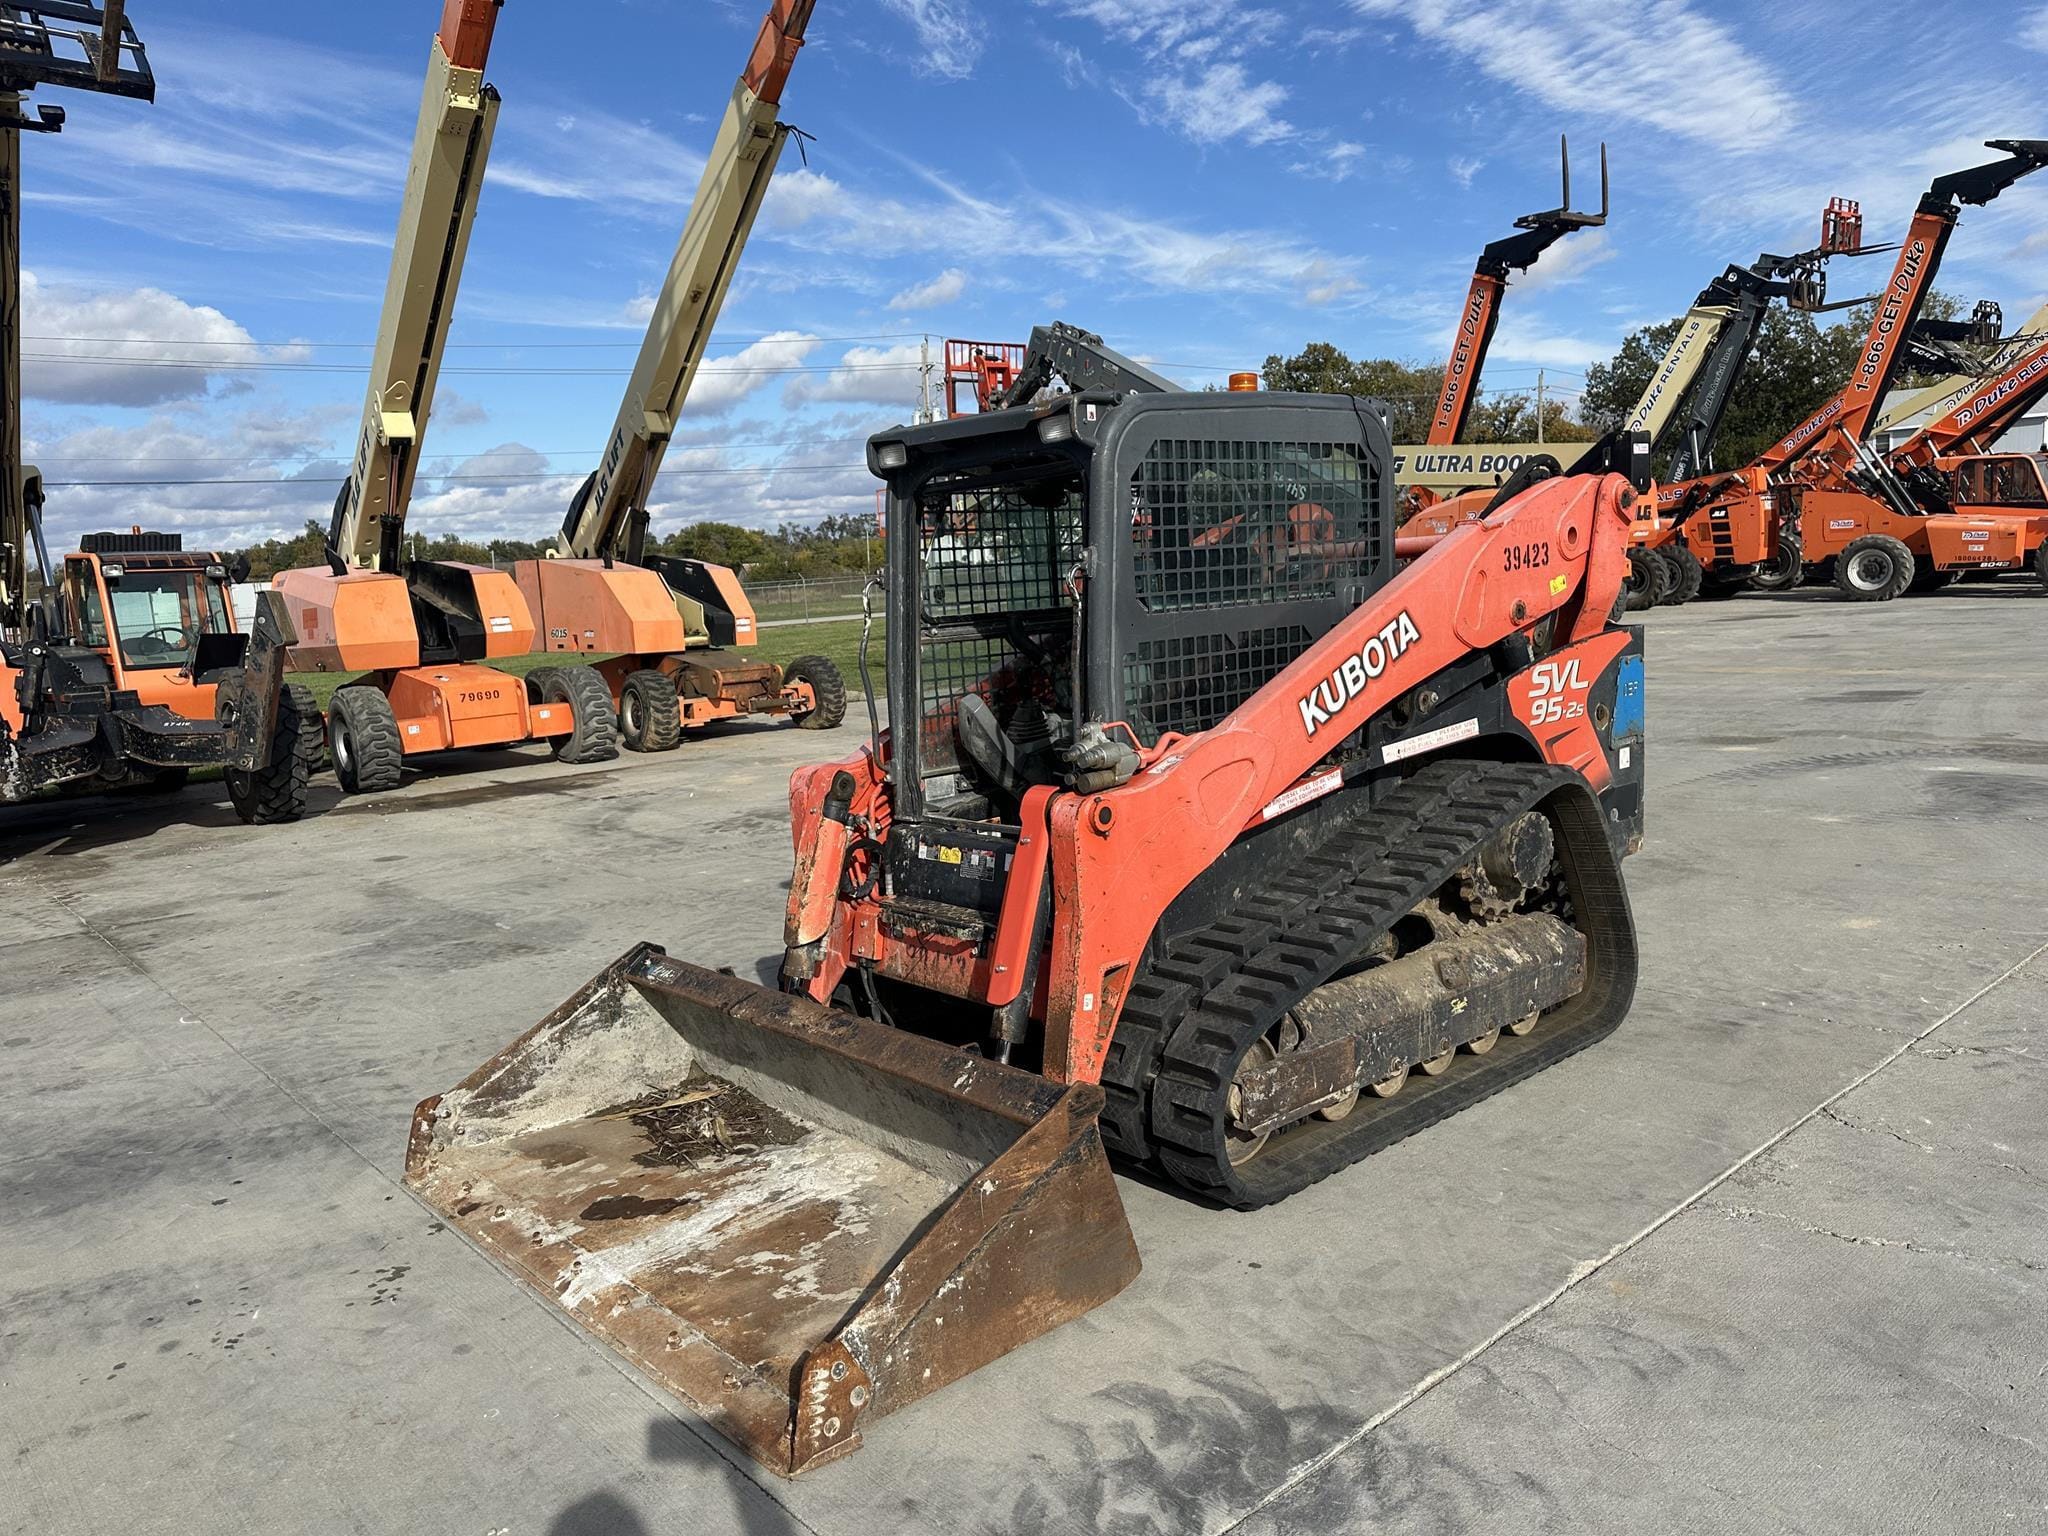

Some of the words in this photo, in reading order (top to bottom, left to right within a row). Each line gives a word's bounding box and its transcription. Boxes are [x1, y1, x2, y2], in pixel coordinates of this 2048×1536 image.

[1661, 321, 1700, 385] RENTALS
[606, 426, 624, 478] LIFT
[1414, 455, 1477, 474] ULTRA
[1478, 454, 1530, 474] BOO
[1503, 541, 1549, 572] 39423
[1298, 610, 1422, 736] KUBOTA
[1528, 658, 1590, 699] SVL
[458, 690, 501, 704] 79690
